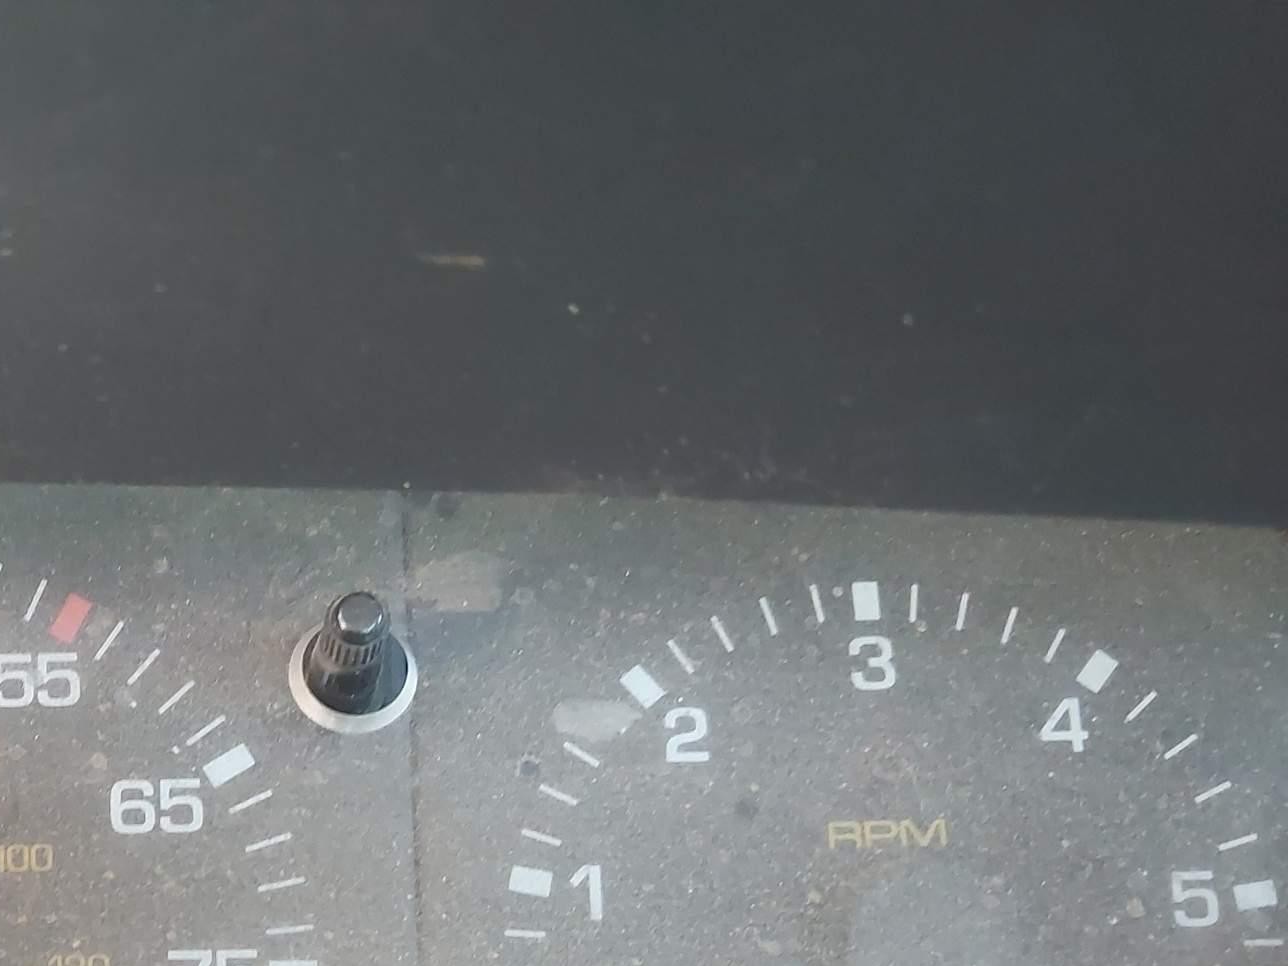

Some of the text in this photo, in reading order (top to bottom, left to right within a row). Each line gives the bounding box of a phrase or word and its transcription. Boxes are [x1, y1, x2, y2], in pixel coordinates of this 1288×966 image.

[848, 635, 896, 691] 3
[663, 706, 711, 763] 2
[1040, 697, 1089, 753] 4
[109, 778, 204, 834] 65
[827, 819, 948, 849] RPM
[569, 864, 604, 921] 1
[1171, 871, 1219, 928] 5
